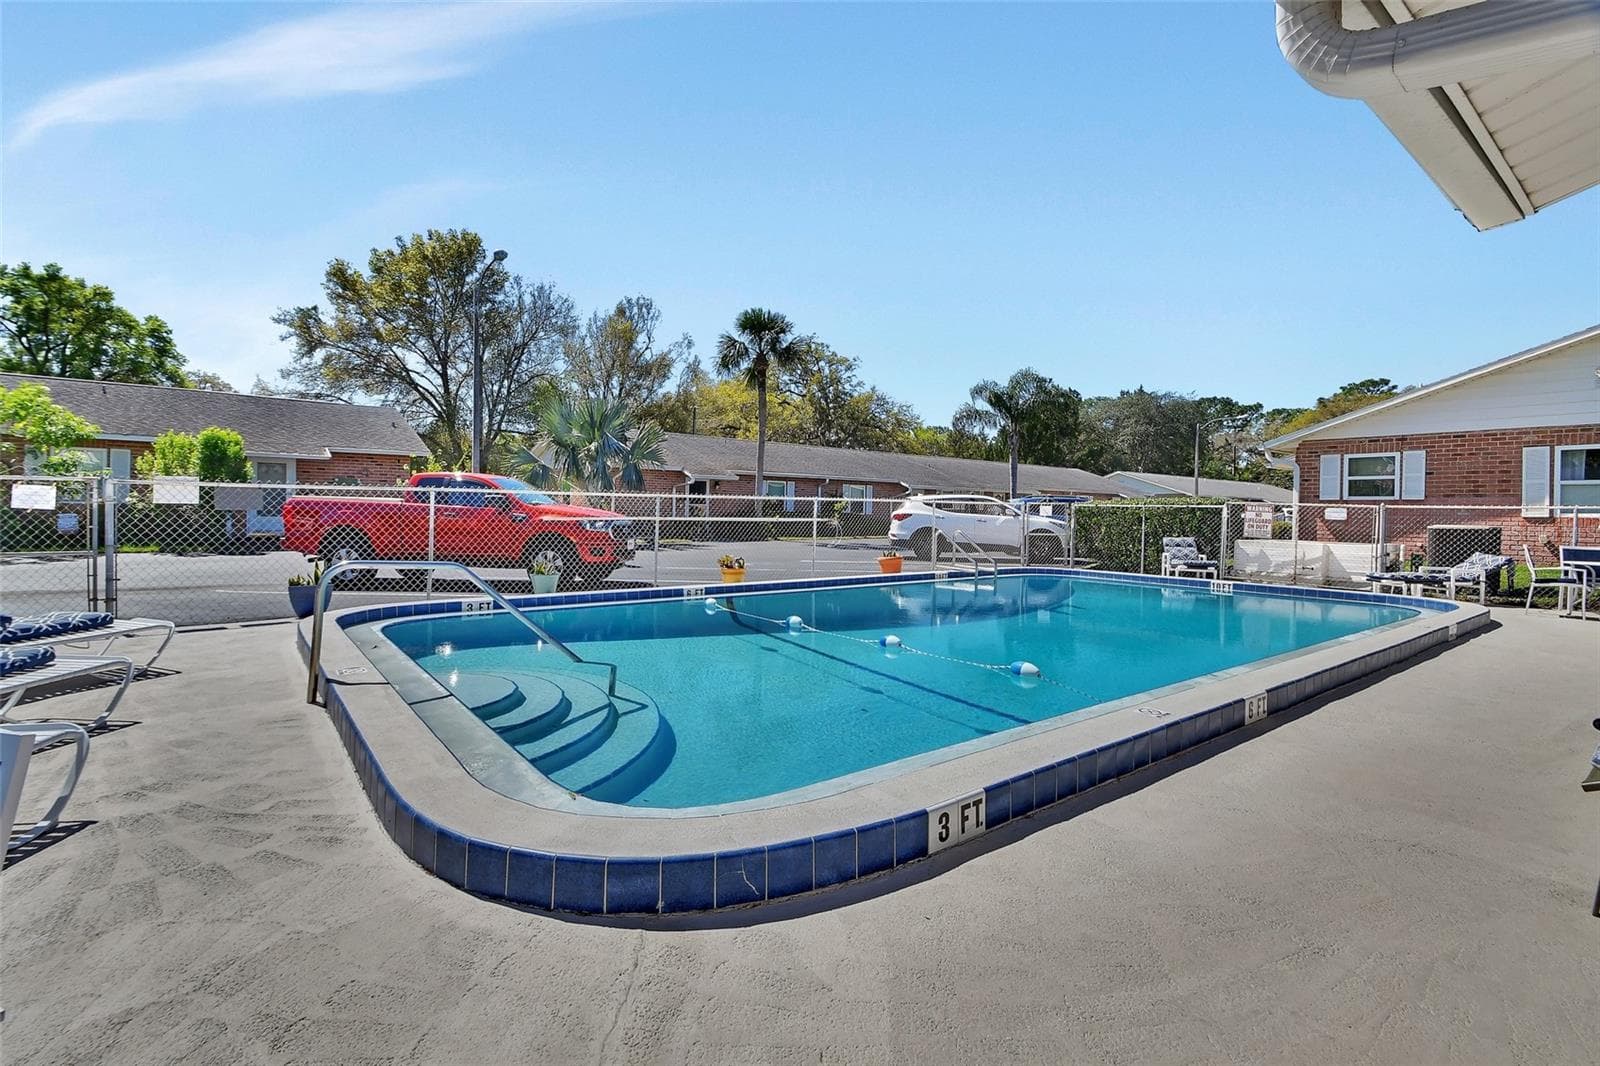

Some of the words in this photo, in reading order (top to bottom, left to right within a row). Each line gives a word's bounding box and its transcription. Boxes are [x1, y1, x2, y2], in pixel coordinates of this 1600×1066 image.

[466, 603, 474, 612] 3
[478, 602, 491, 611] FT
[1248, 701, 1254, 718] 6
[938, 811, 950, 843] 3
[961, 797, 983, 834] FT.
